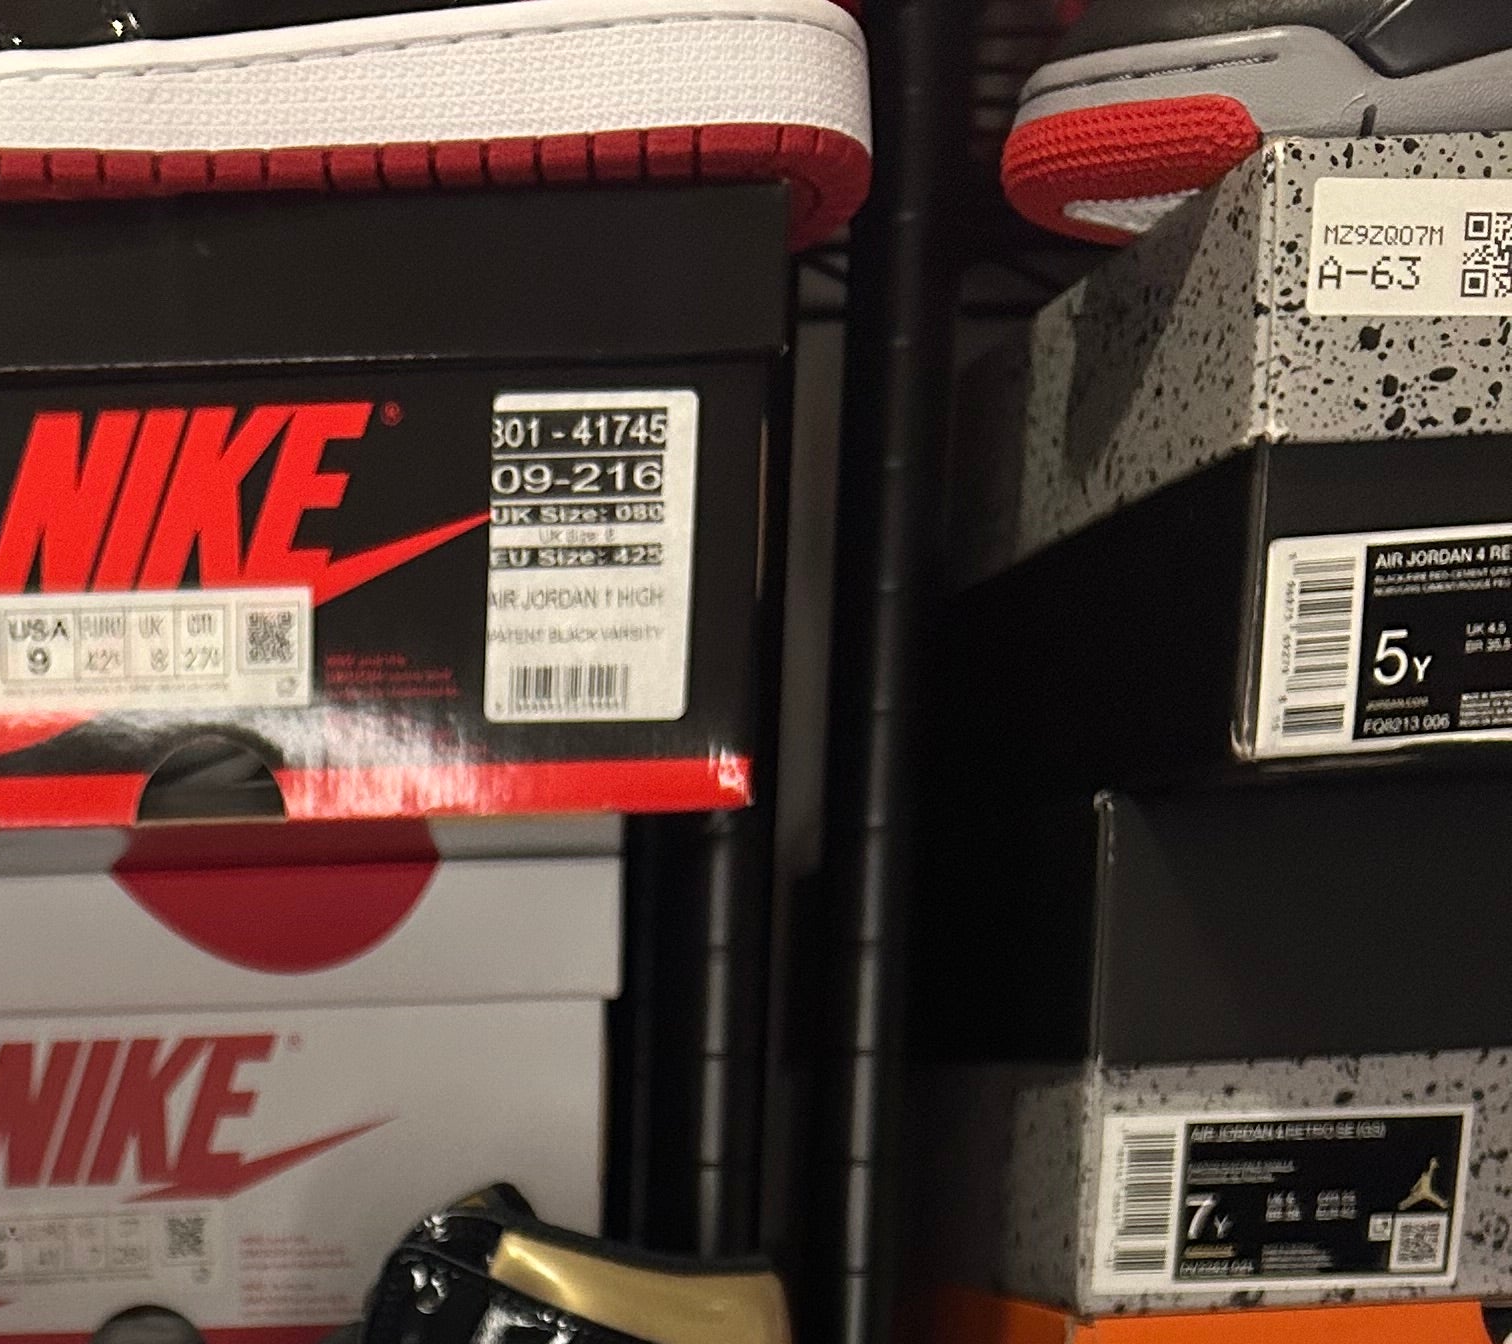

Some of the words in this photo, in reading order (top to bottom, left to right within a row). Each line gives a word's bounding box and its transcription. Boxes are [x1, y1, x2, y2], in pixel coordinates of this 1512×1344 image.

[1317, 255, 1422, 290] A-63
[571, 413, 668, 447] 41745
[491, 460, 664, 495] 09-216
[491, 506, 532, 525] UK
[539, 505, 608, 524] Size:
[489, 548, 531, 568] EU
[538, 548, 608, 568] Size:
[1374, 551, 1404, 570] AIR
[1406, 547, 1473, 567] JORDAN
[1475, 546, 1486, 563] 4
[521, 588, 598, 610] JORDAN
[8, 616, 71, 643] USA
